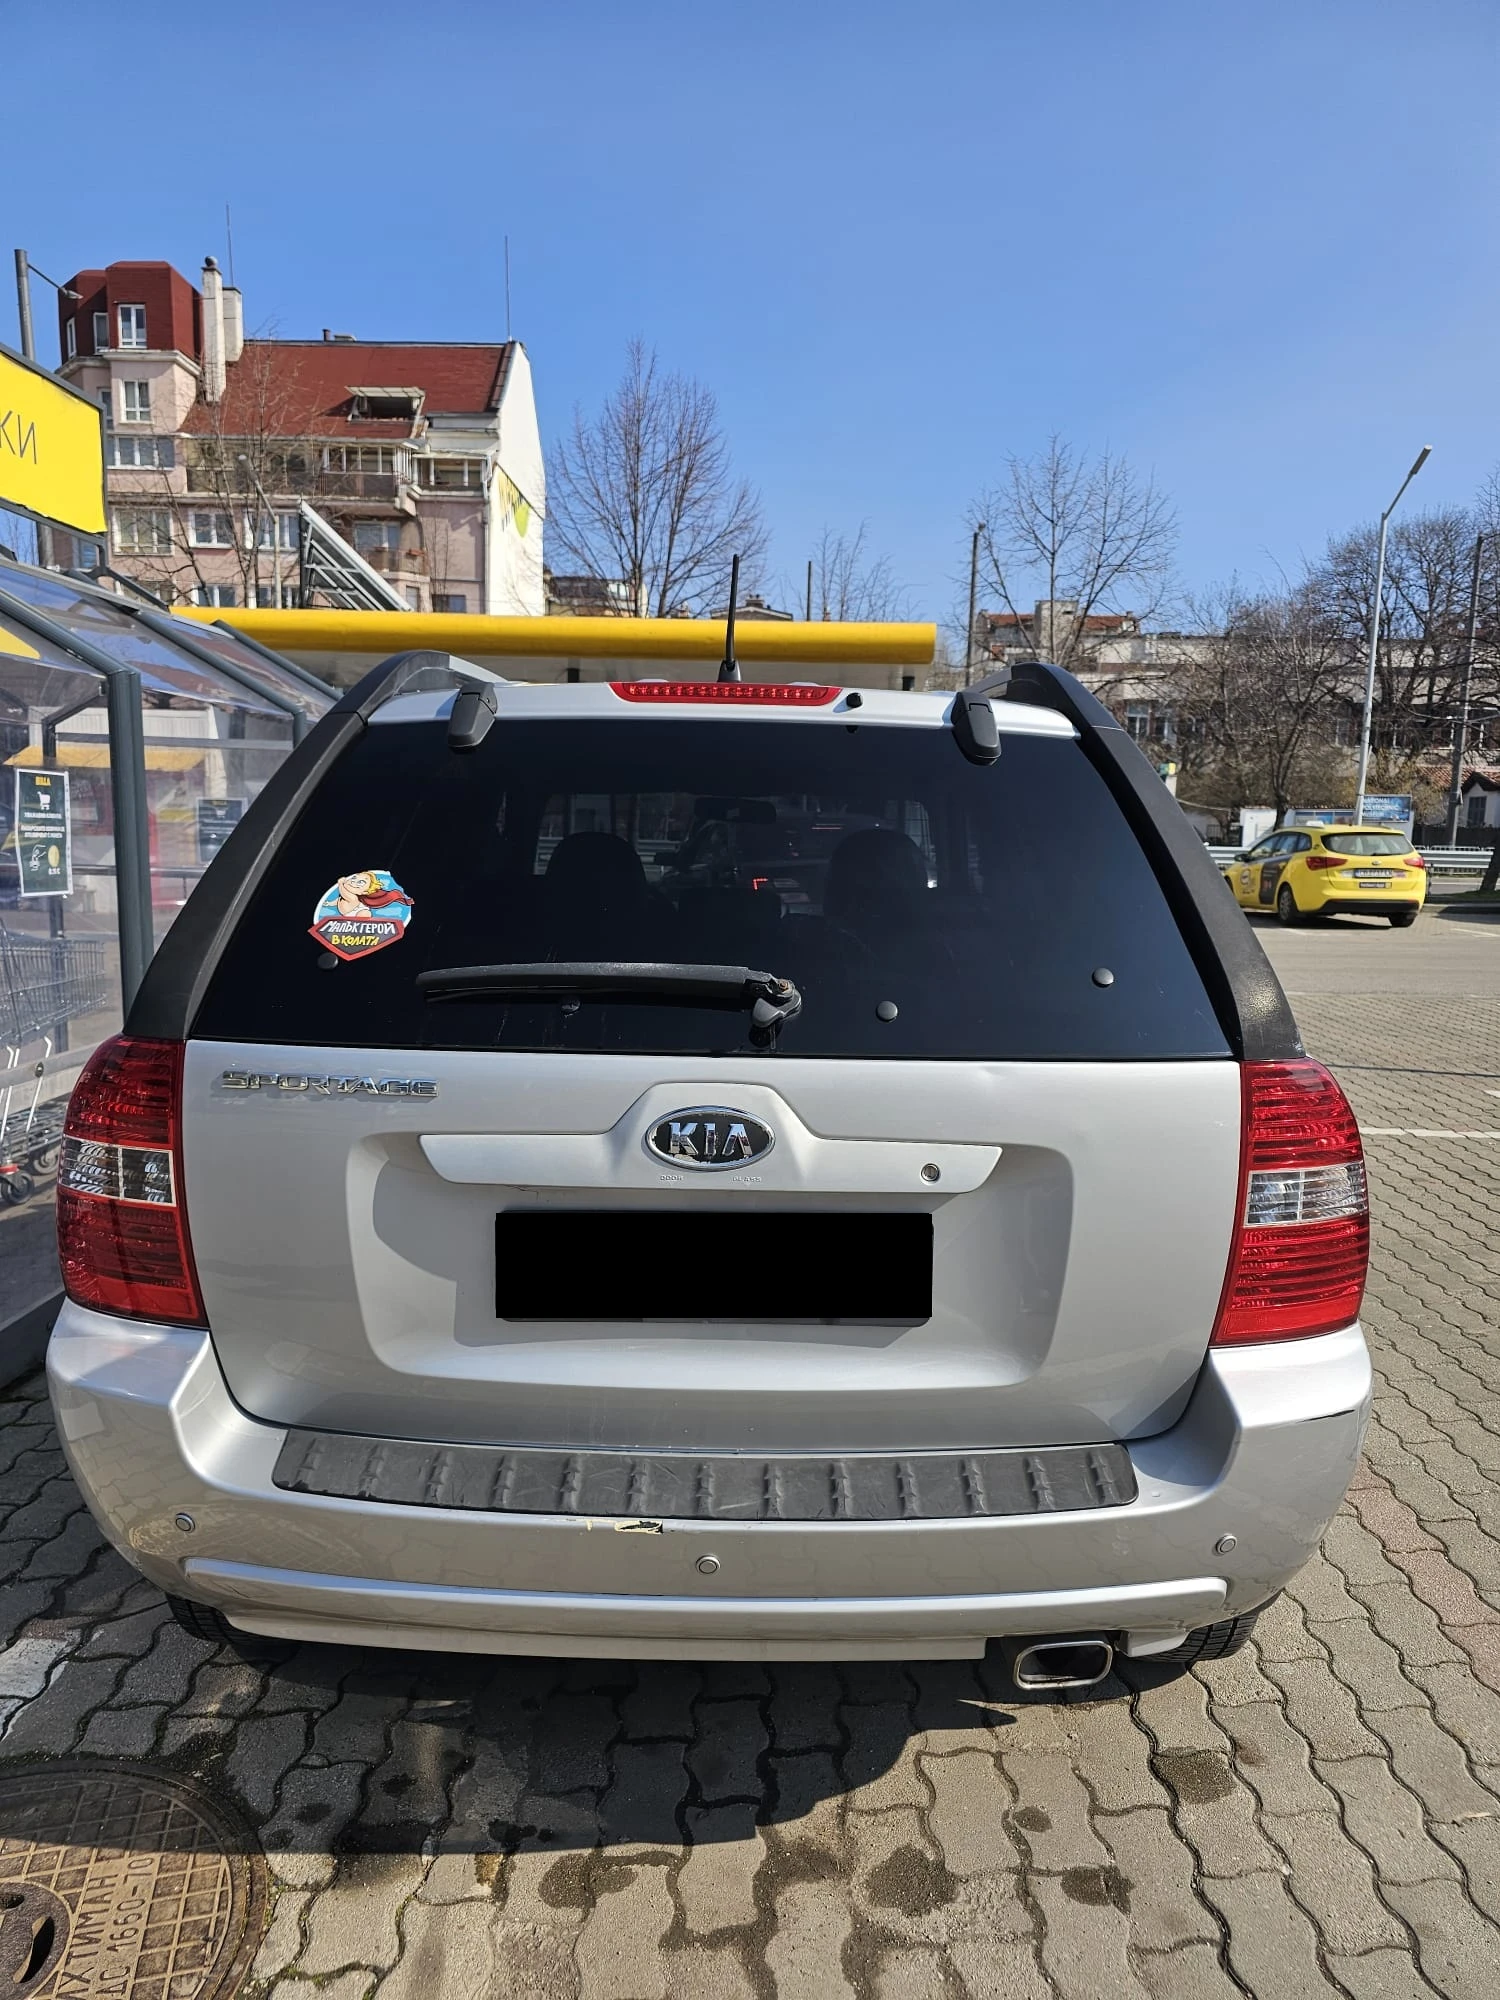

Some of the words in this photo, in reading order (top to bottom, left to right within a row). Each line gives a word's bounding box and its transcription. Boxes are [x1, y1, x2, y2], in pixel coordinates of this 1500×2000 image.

[360, 922, 396, 934] ГЕРОЙ
[341, 934, 380, 947] КОЛАТА
[221, 1070, 439, 1098] SPORTAGE
[668, 1121, 753, 1158] KIA
